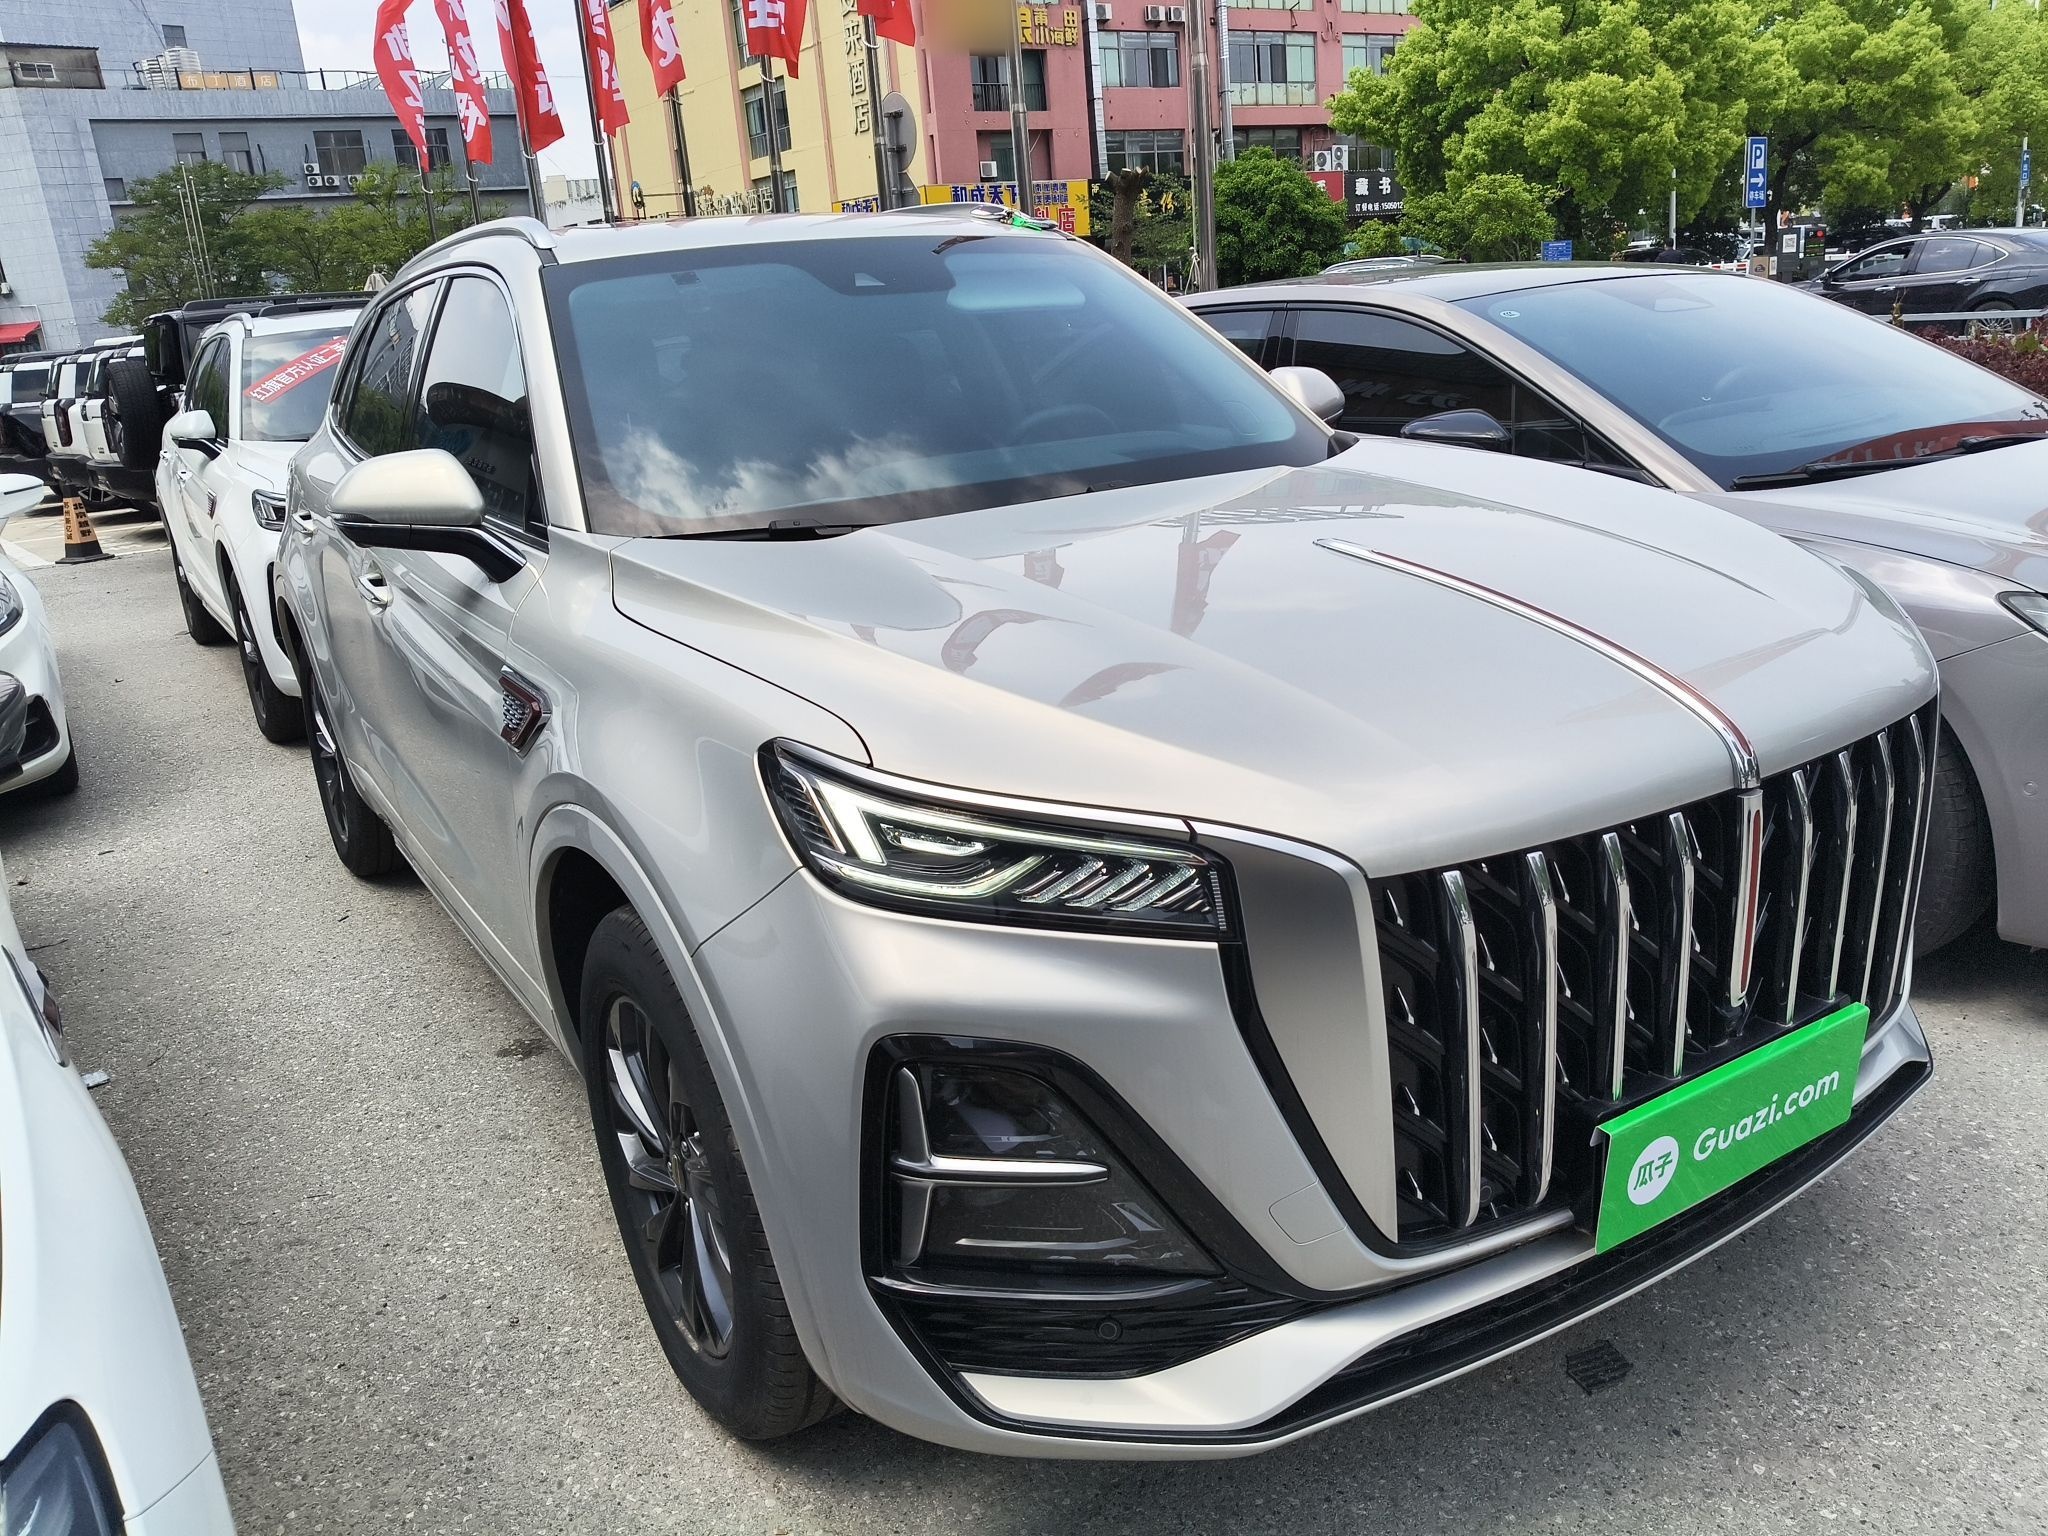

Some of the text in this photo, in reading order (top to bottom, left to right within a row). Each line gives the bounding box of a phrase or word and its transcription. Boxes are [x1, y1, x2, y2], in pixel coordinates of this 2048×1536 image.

[186, 75, 272, 87] 布丁酒店
[1753, 146, 1762, 168] P
[1749, 190, 1765, 201] 停车场
[250, 339, 348, 401] 红旗官方认证二手
[1693, 1070, 1840, 1162] Guazi.com
[1633, 1151, 1673, 1191] 瓜子
